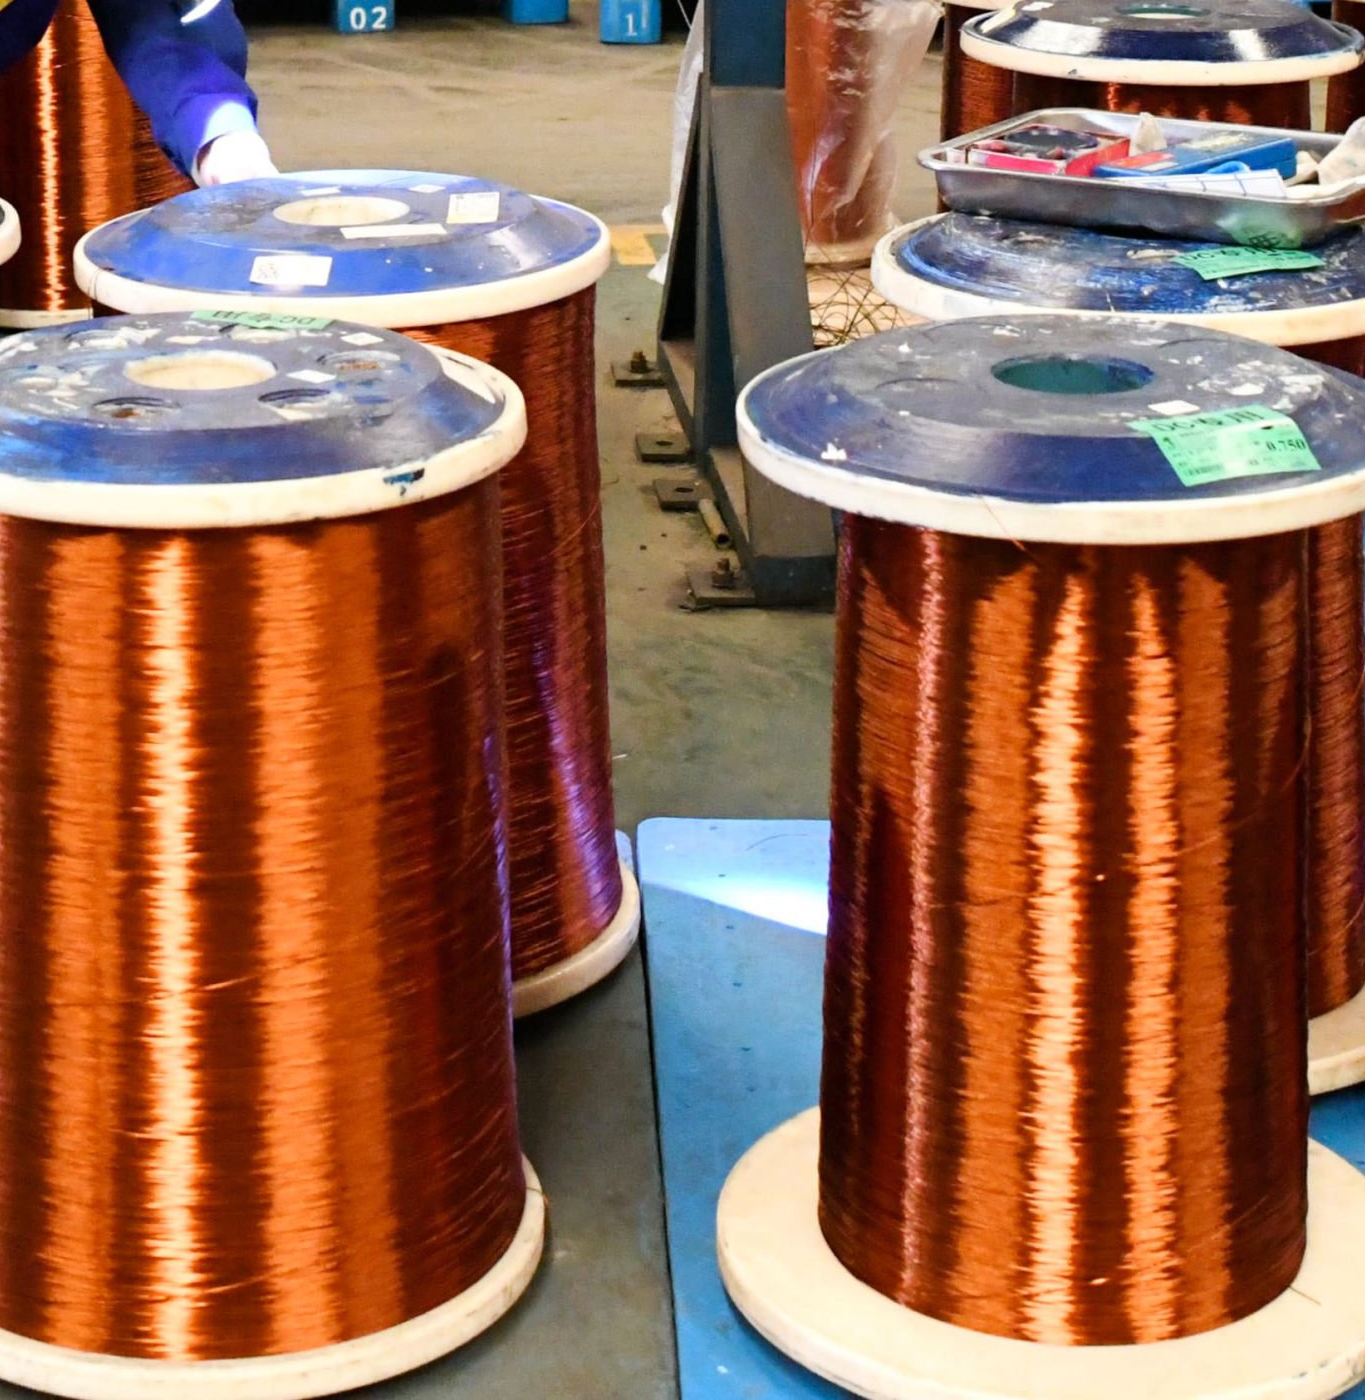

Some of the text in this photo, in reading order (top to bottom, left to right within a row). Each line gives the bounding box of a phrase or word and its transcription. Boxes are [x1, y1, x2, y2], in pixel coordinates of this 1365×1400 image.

[350, 6, 387, 30] 02
[626, 13, 638, 36] 1
[1265, 438, 1307, 452] 0.750
